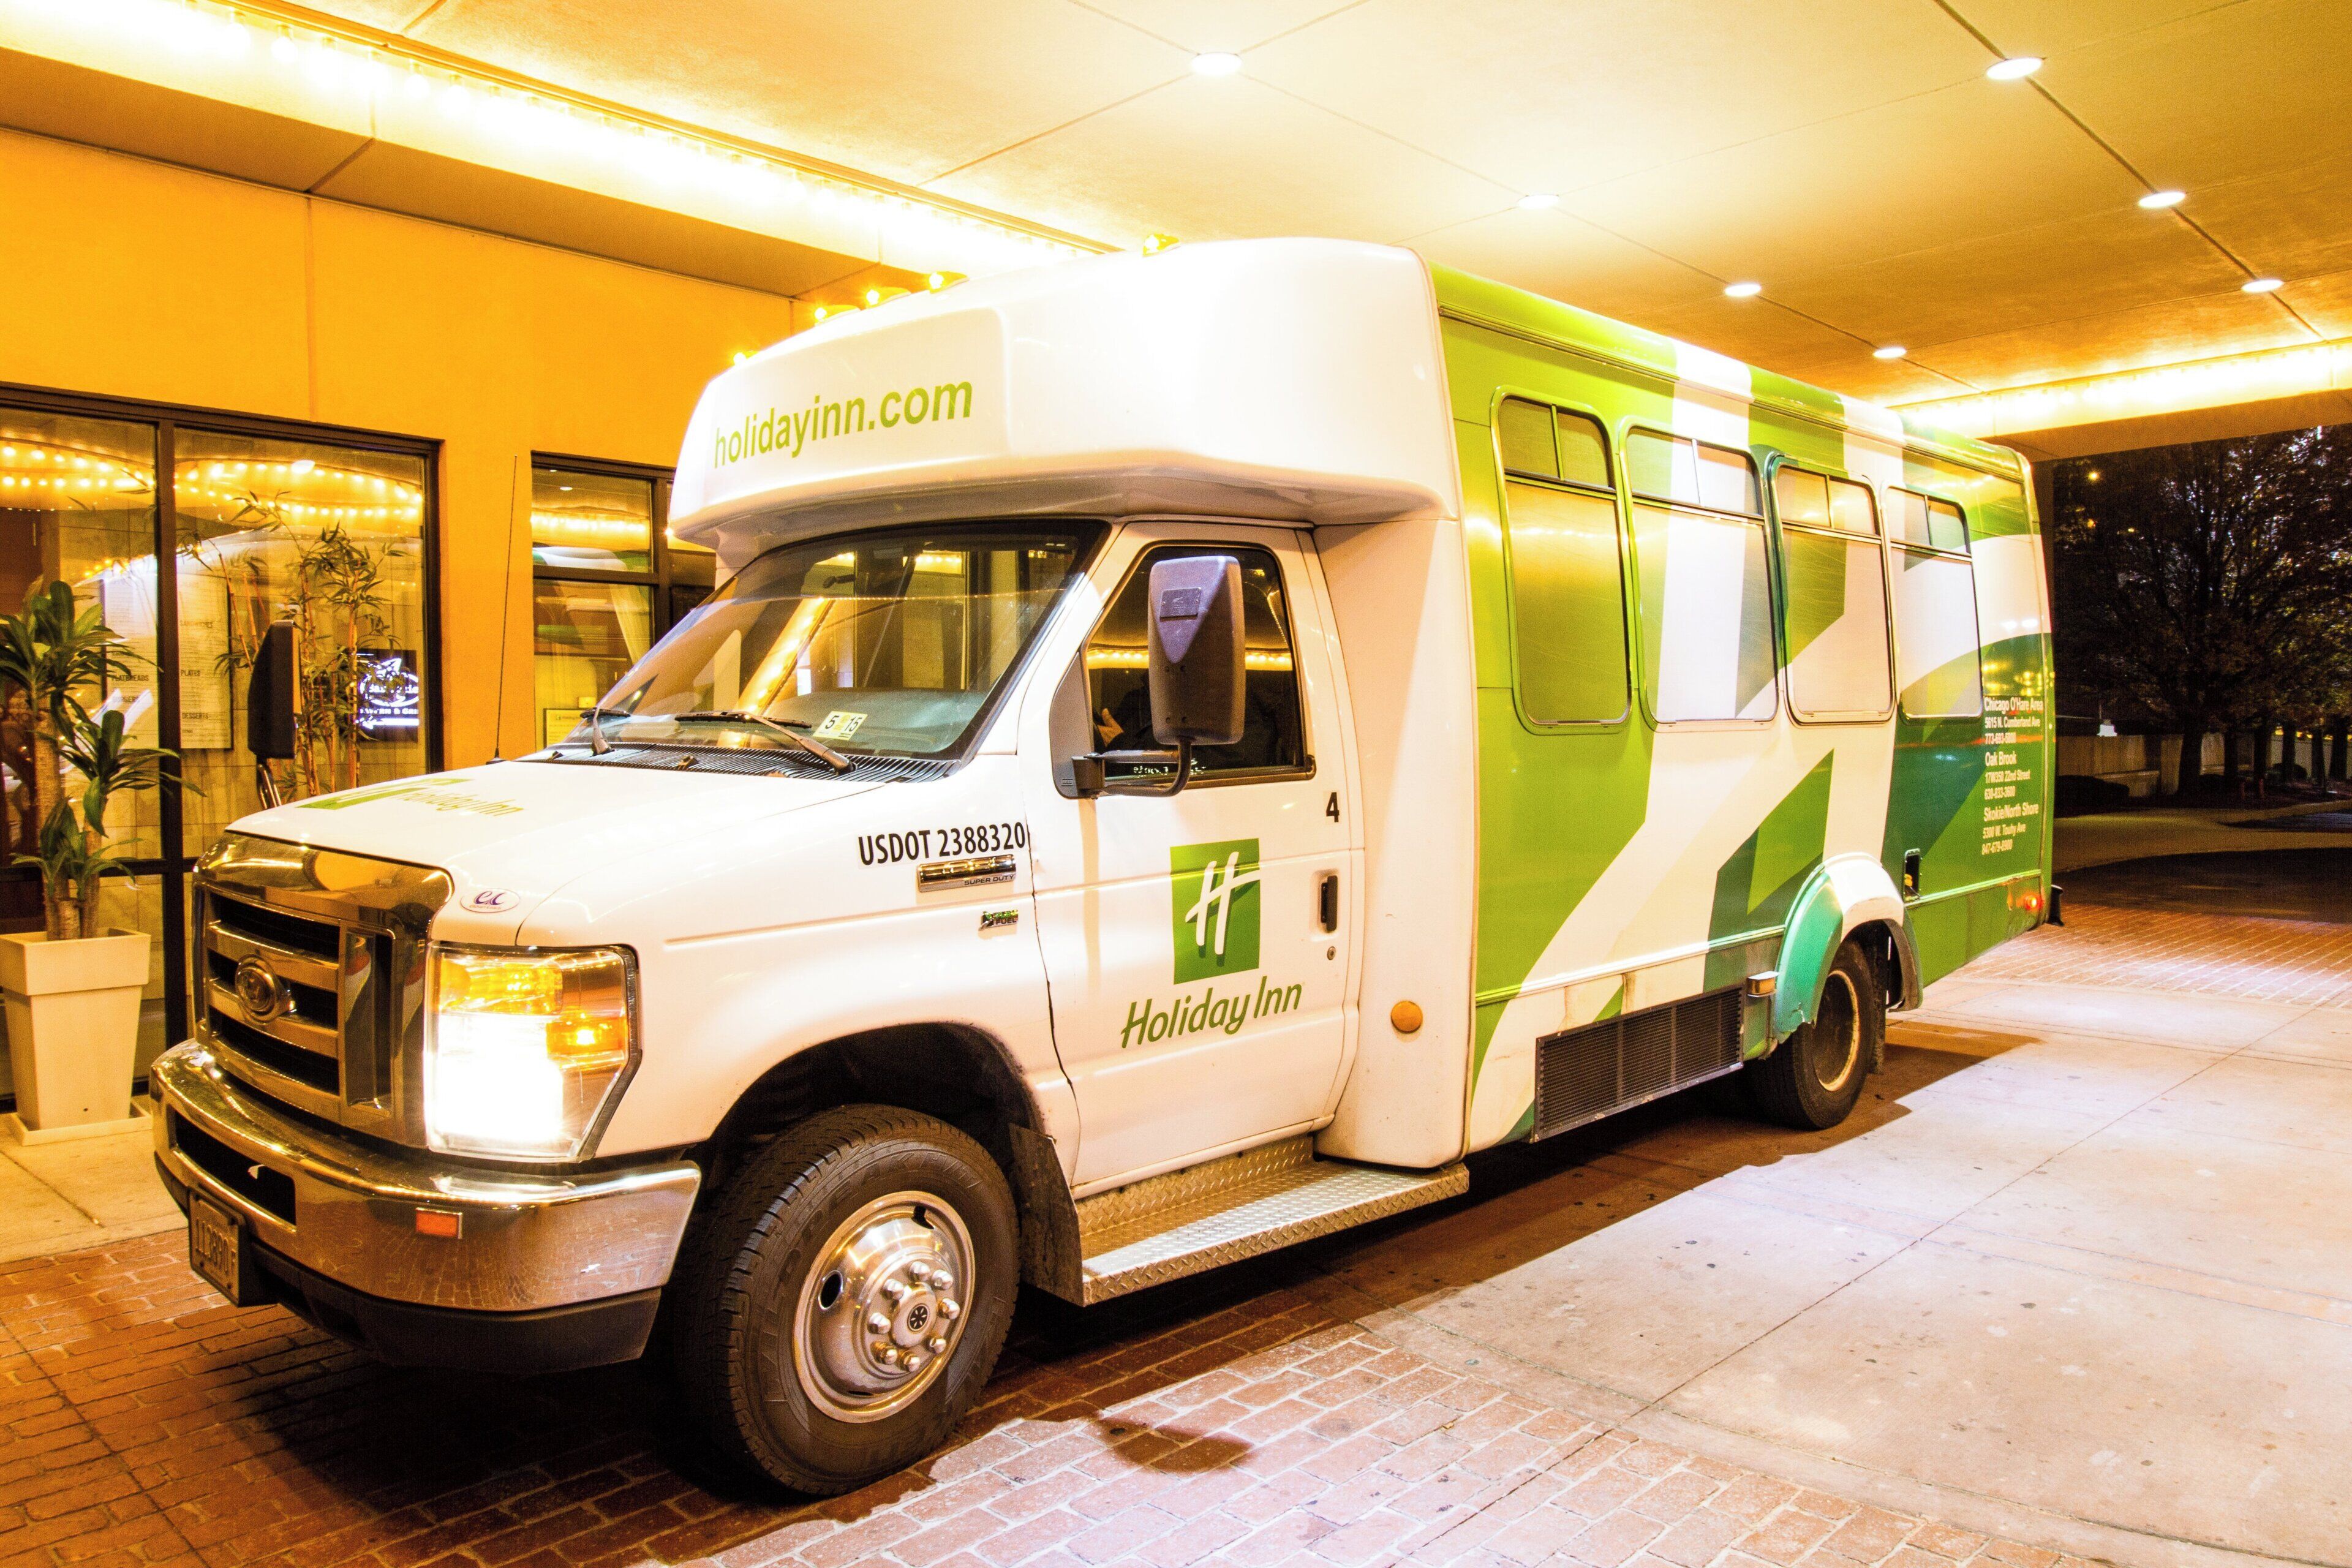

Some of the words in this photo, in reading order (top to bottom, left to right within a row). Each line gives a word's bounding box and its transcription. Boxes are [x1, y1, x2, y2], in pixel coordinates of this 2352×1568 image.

[714, 380, 973, 469] holidayinn.com
[1984, 697, 2009, 714] Chicago
[2010, 696, 2029, 711] O'Hare
[2030, 698, 2043, 711] Area
[825, 715, 839, 729] 5
[845, 717, 862, 732] 15
[2003, 716, 2031, 728] Cumberland
[2032, 716, 2040, 727] Ave
[1985, 752, 1997, 766] Oak
[1999, 751, 2017, 765] Brook
[2004, 770, 2016, 782] 22nd
[2016, 769, 2030, 781] Street
[1325, 792, 1340, 823] 4
[2021, 802, 2039, 816] Shore
[2016, 822, 2026, 833] Ave
[858, 829, 930, 865] USDOT
[937, 821, 1025, 857] 2388320
[1120, 987, 1251, 1048] Holiday
[1253, 975, 1302, 1019] Inn
